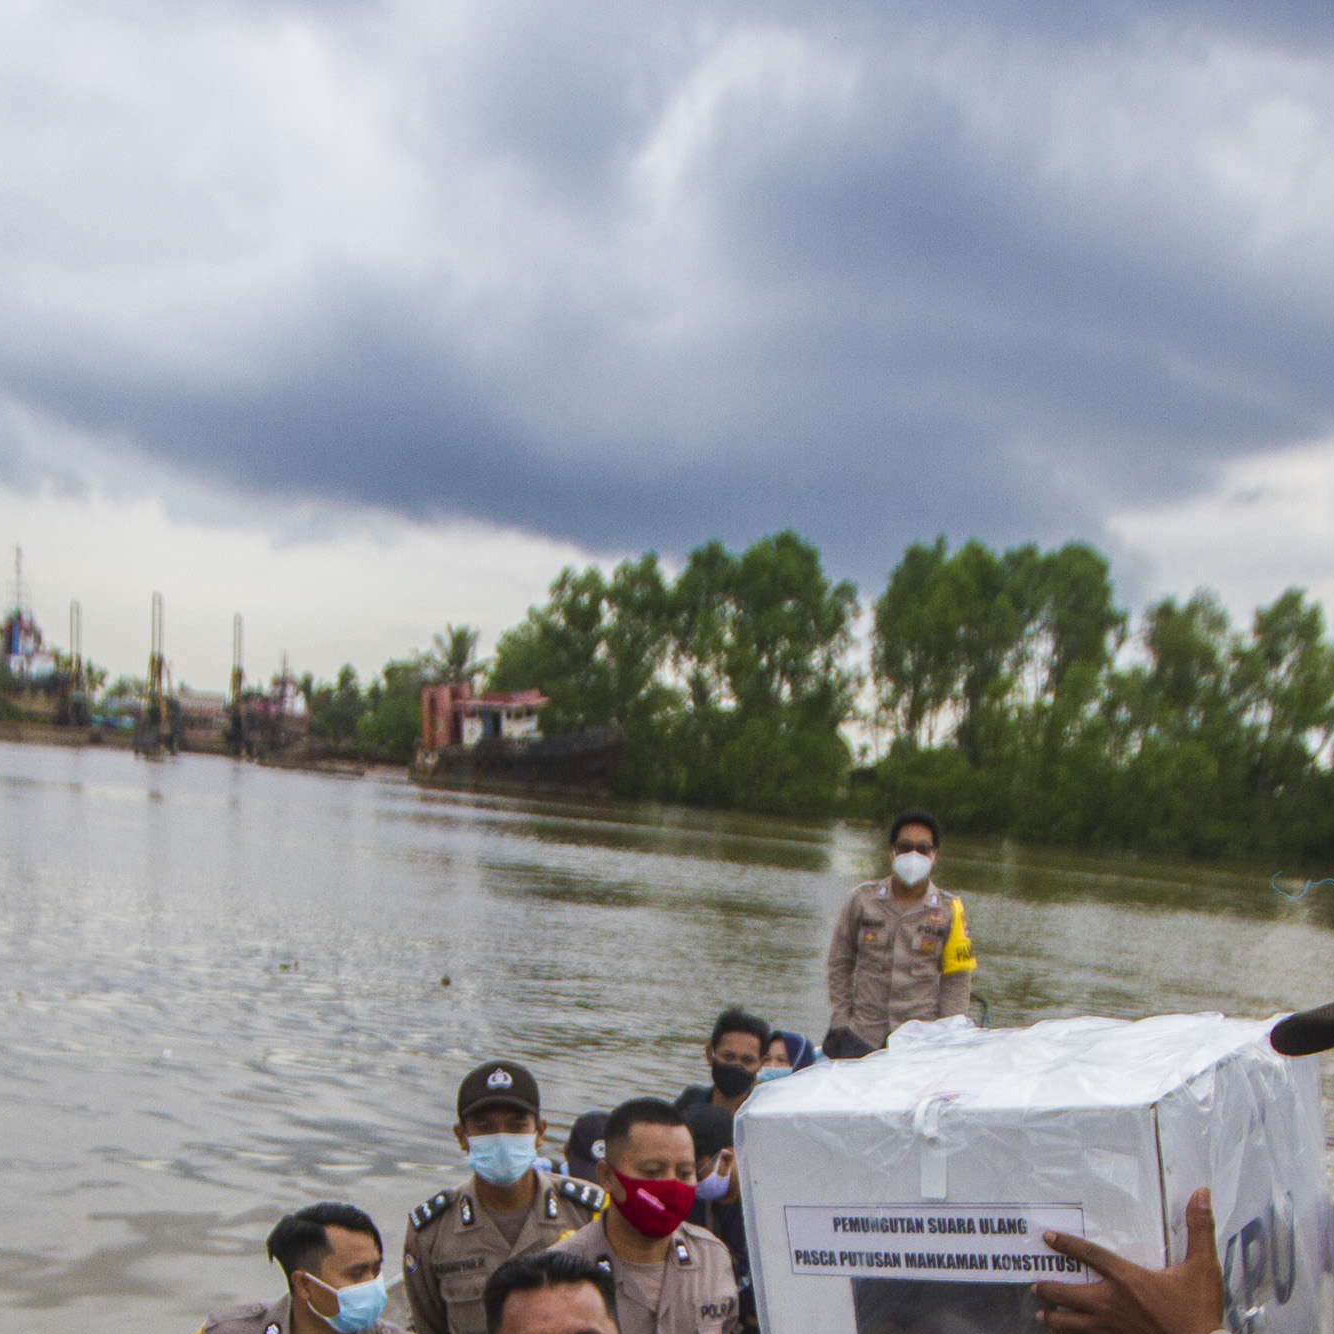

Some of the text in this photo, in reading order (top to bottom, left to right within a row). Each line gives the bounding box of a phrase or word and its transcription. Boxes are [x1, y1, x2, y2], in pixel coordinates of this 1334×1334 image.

[832, 1216, 1028, 1235] PEMUNGUTAN SUARA ULANG
[794, 1249, 837, 1266] PASCA
[839, 1250, 902, 1268] PUTUSAN
[904, 1252, 988, 1270] MAHKAMAH
